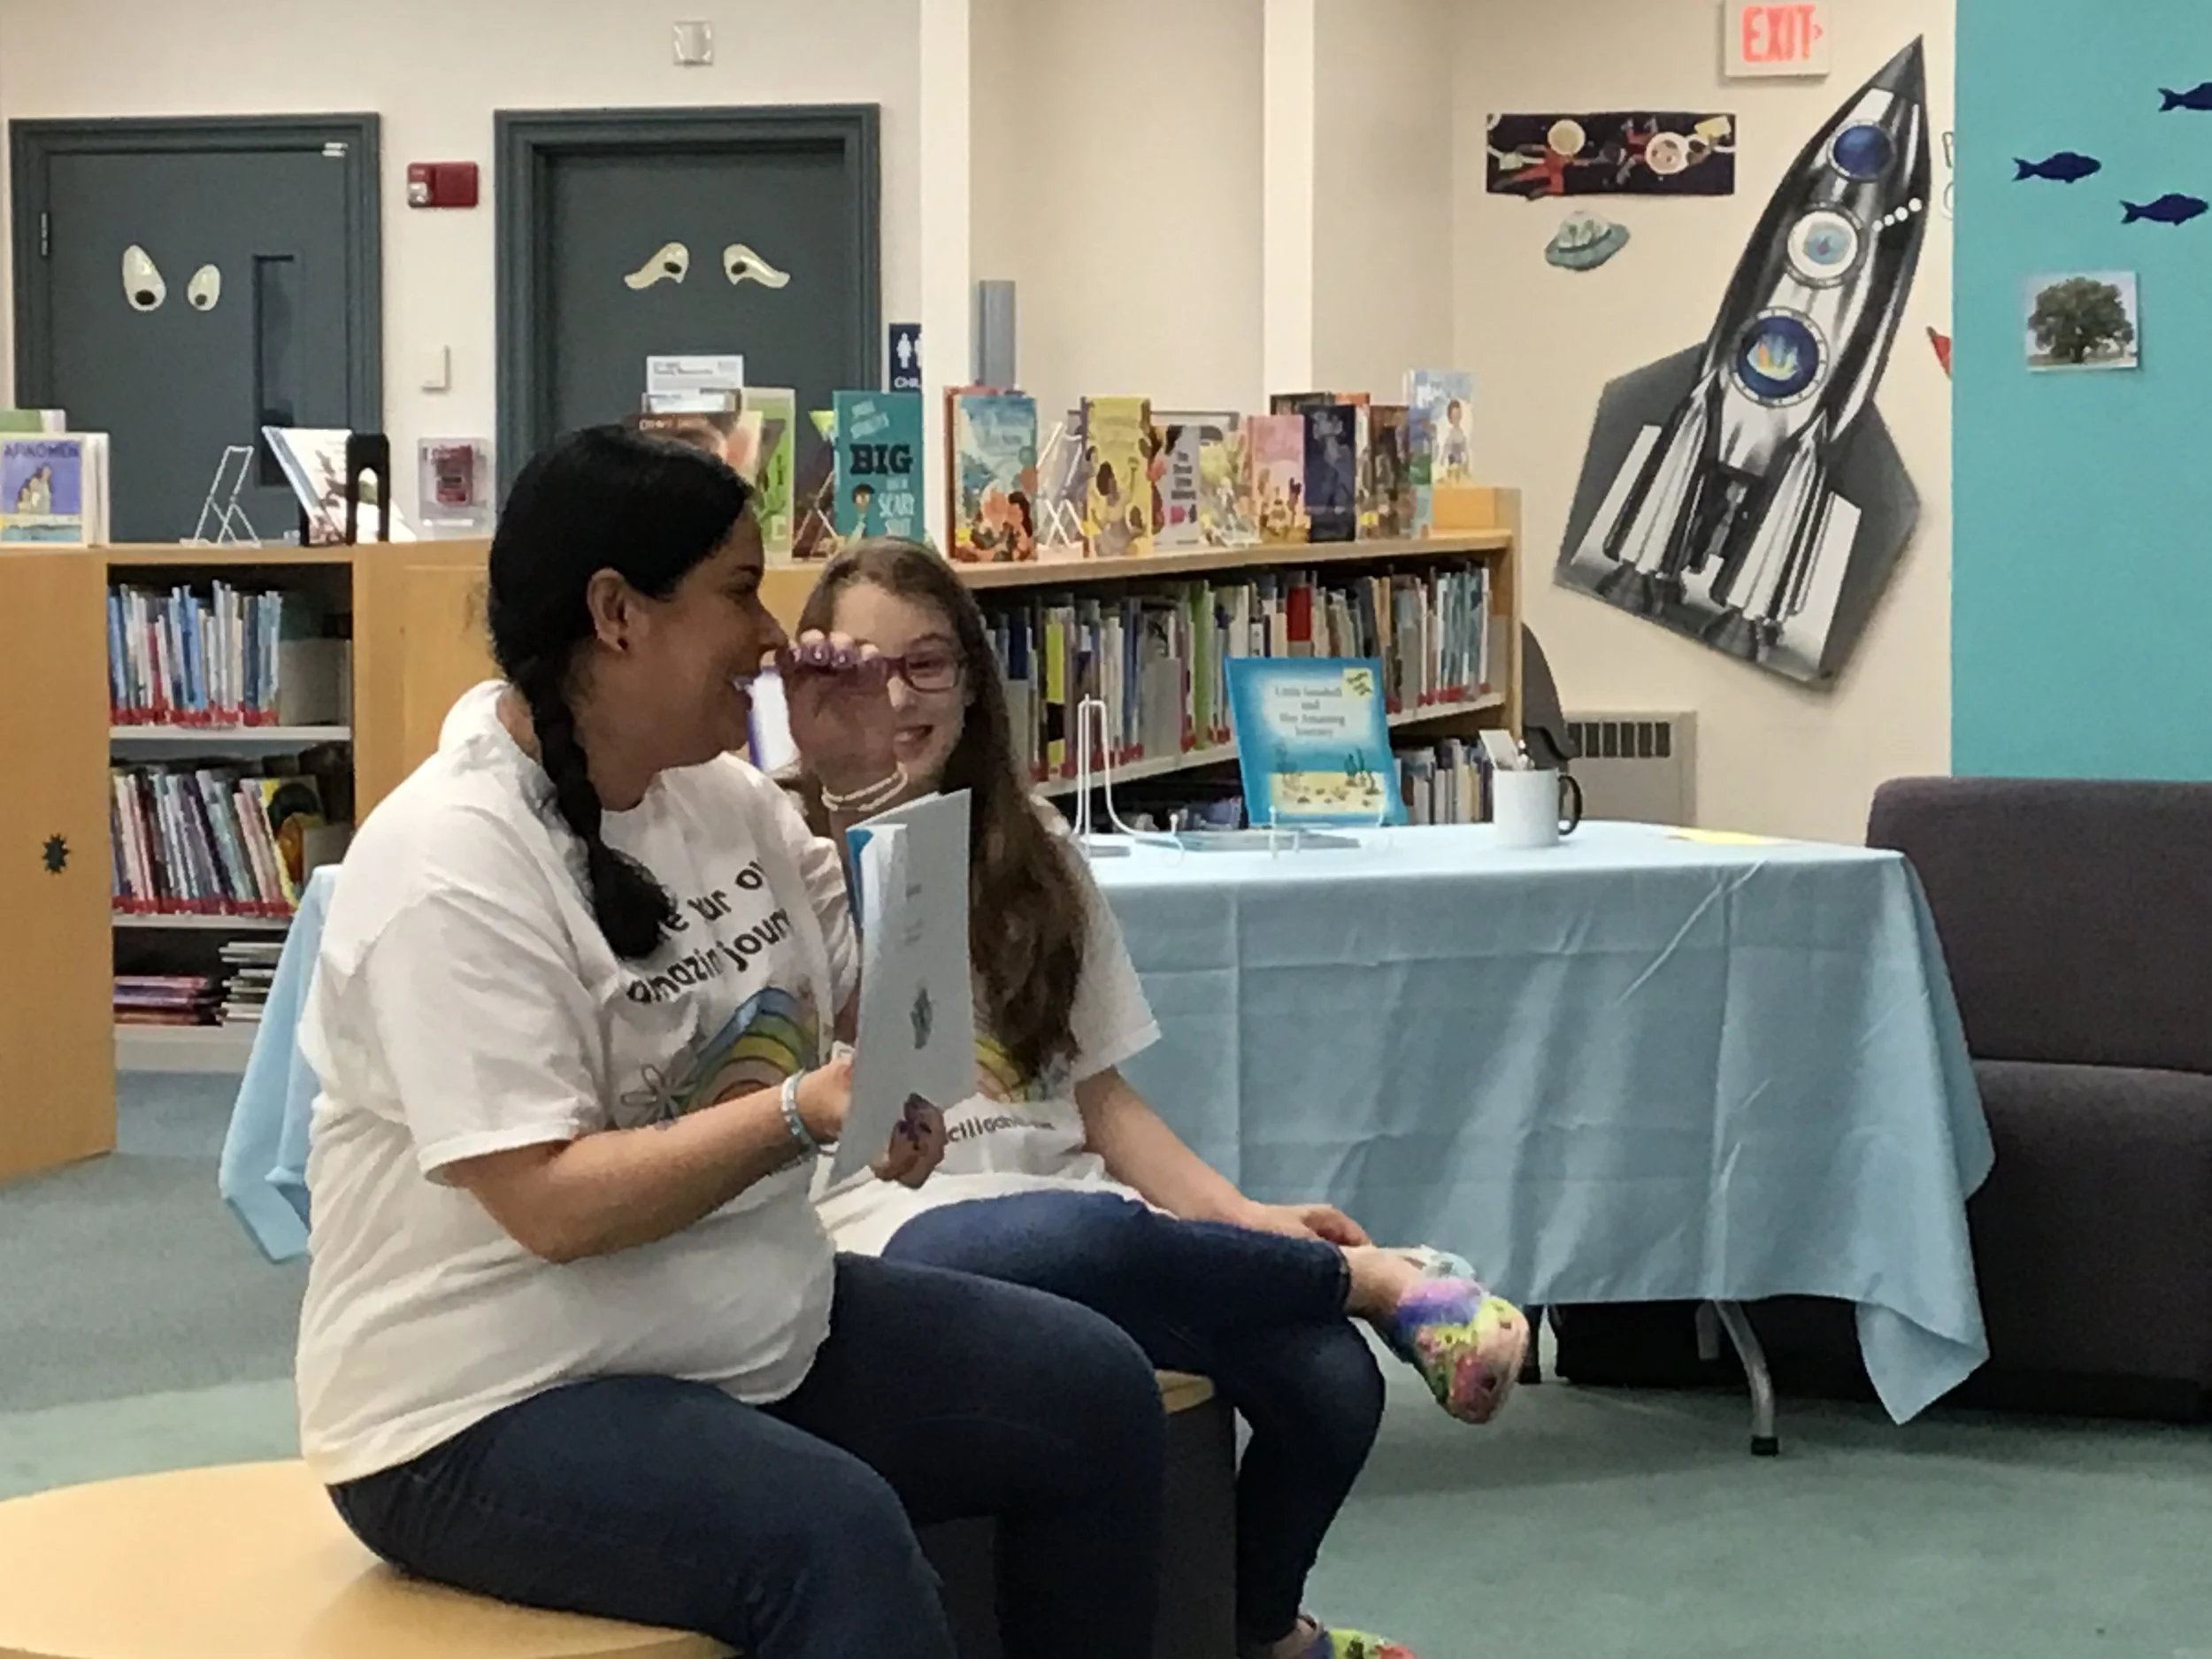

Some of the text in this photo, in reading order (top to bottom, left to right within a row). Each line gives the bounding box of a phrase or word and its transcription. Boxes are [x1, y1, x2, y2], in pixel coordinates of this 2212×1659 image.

[1742, 4, 1814, 62] EXIT
[849, 444, 913, 474] BIG
[687, 889, 732, 921] ur
[626, 949, 725, 1004] amazin
